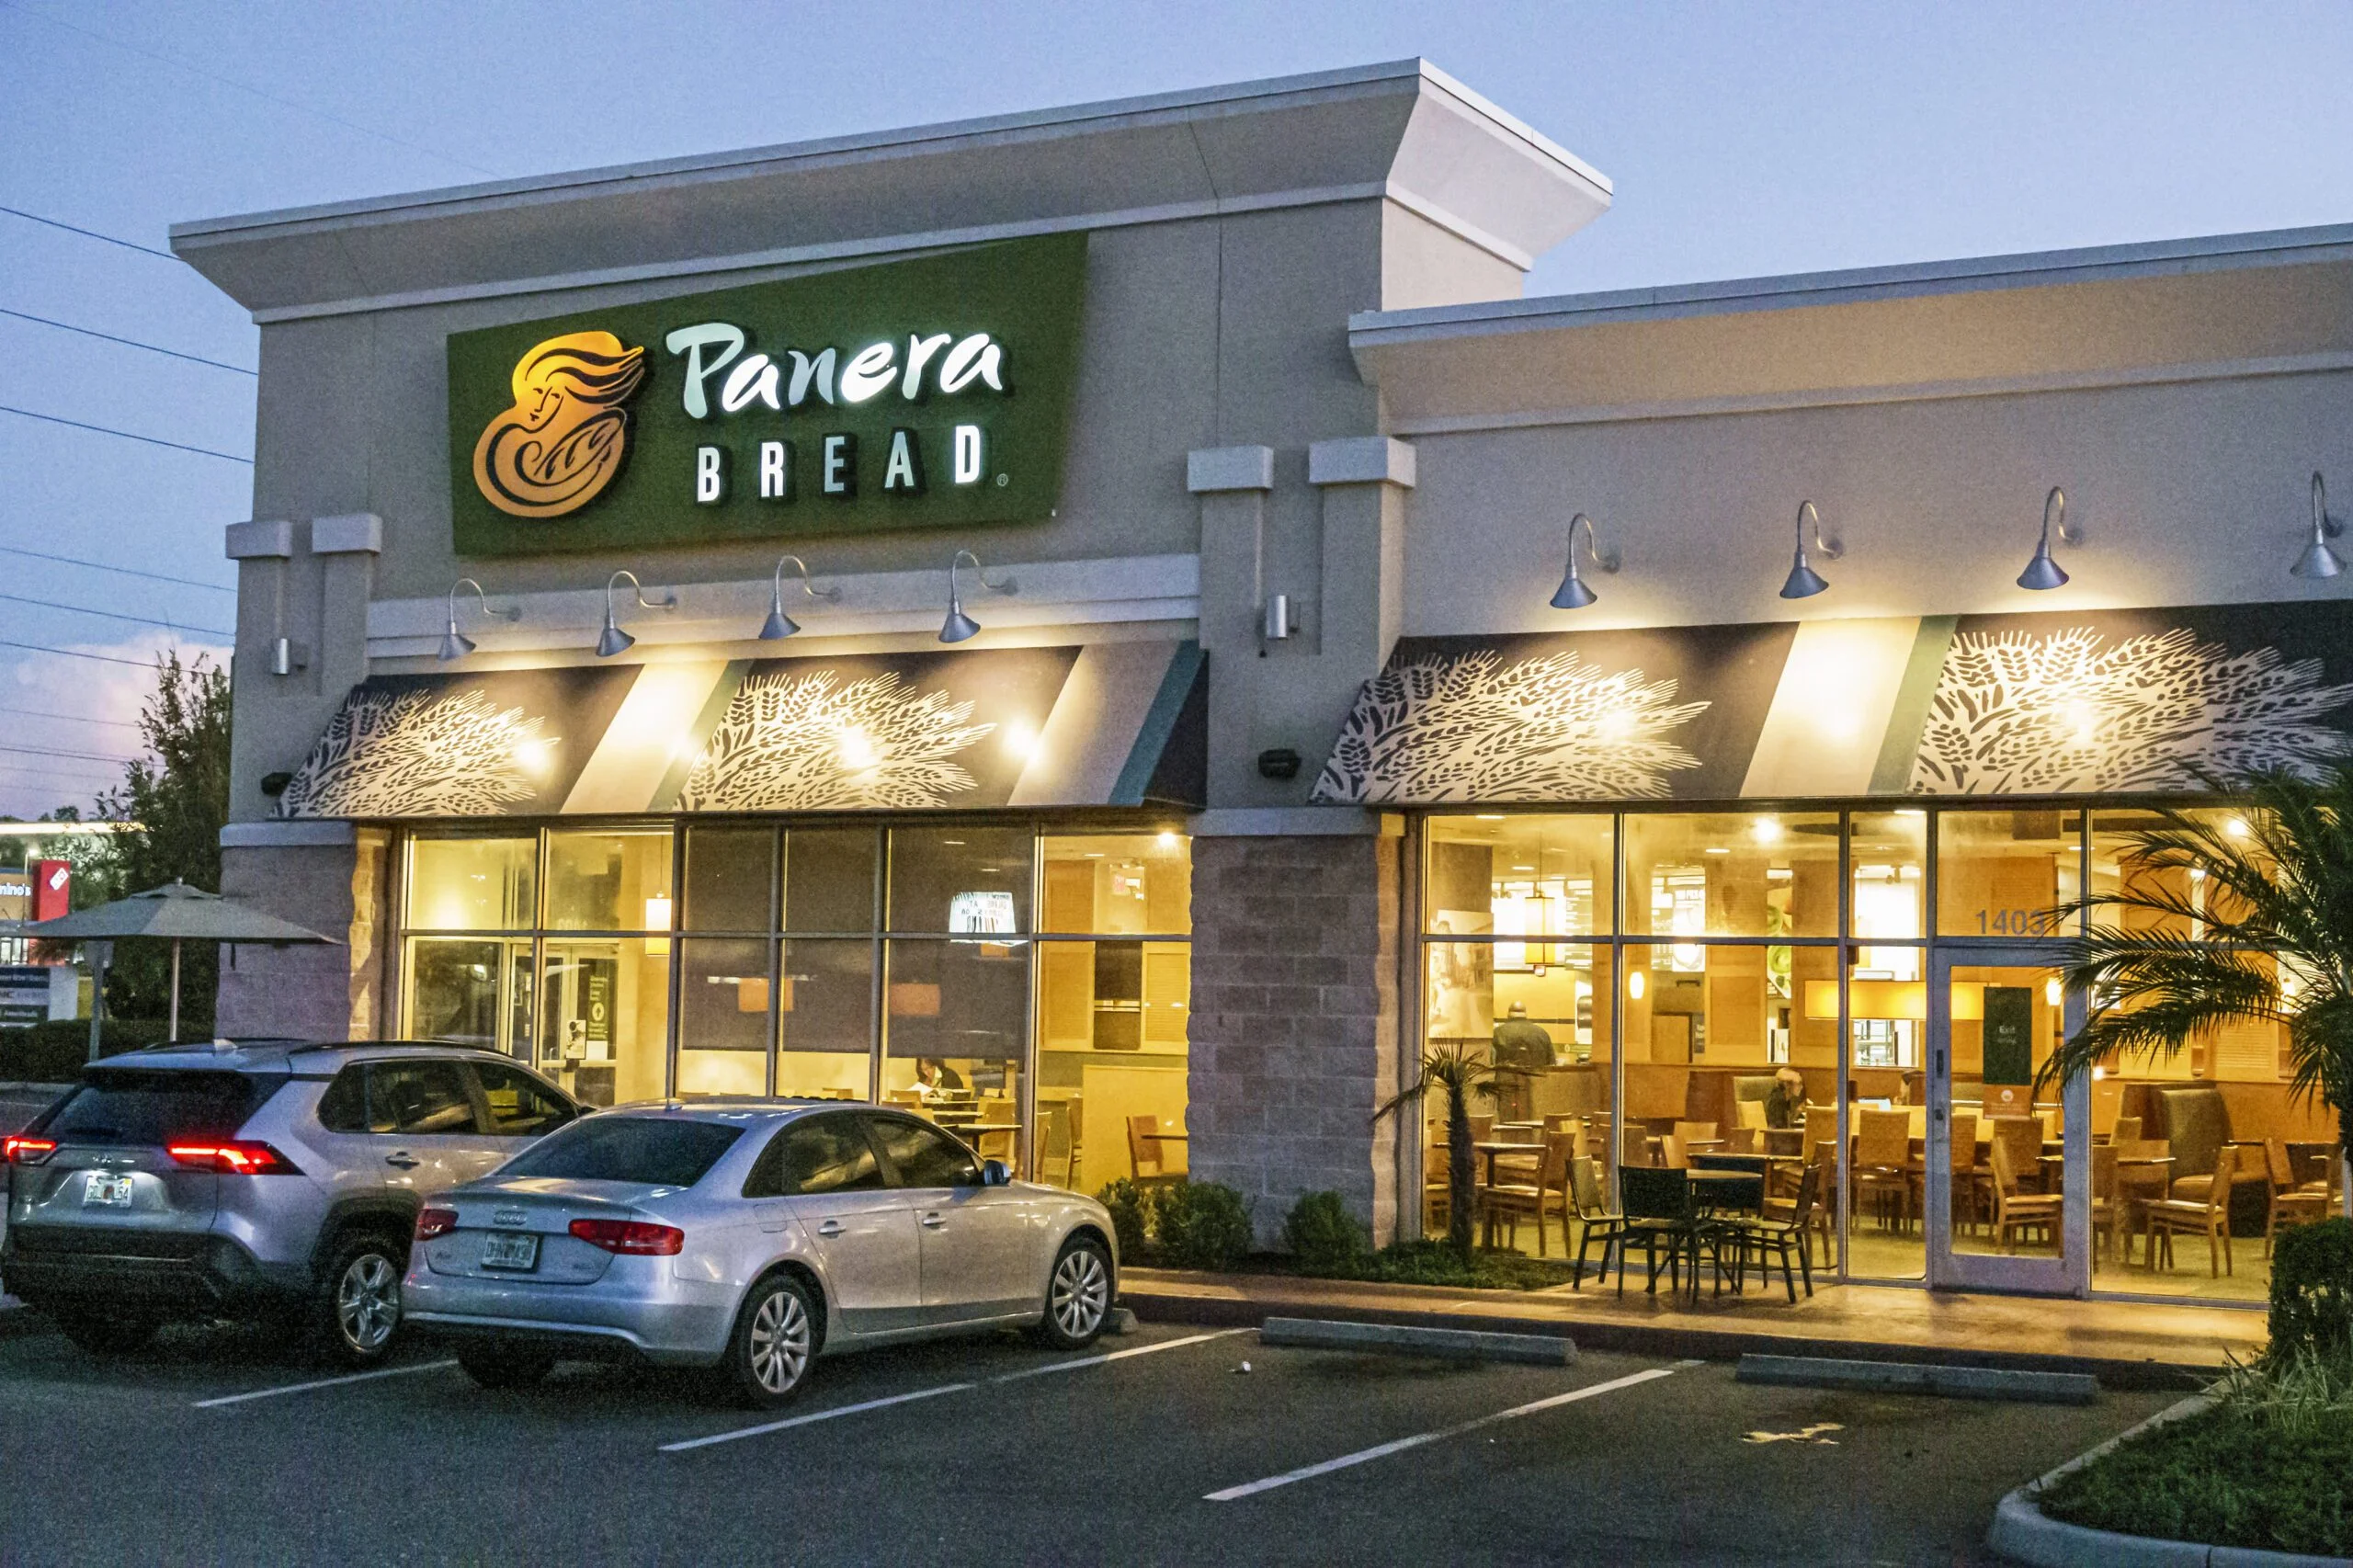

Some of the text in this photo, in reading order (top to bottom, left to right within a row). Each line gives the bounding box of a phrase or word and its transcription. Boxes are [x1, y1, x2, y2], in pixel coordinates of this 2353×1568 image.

[665, 322, 1003, 418] Panera
[696, 424, 982, 504] BREAD
[1975, 909, 2045, 936] 1403
